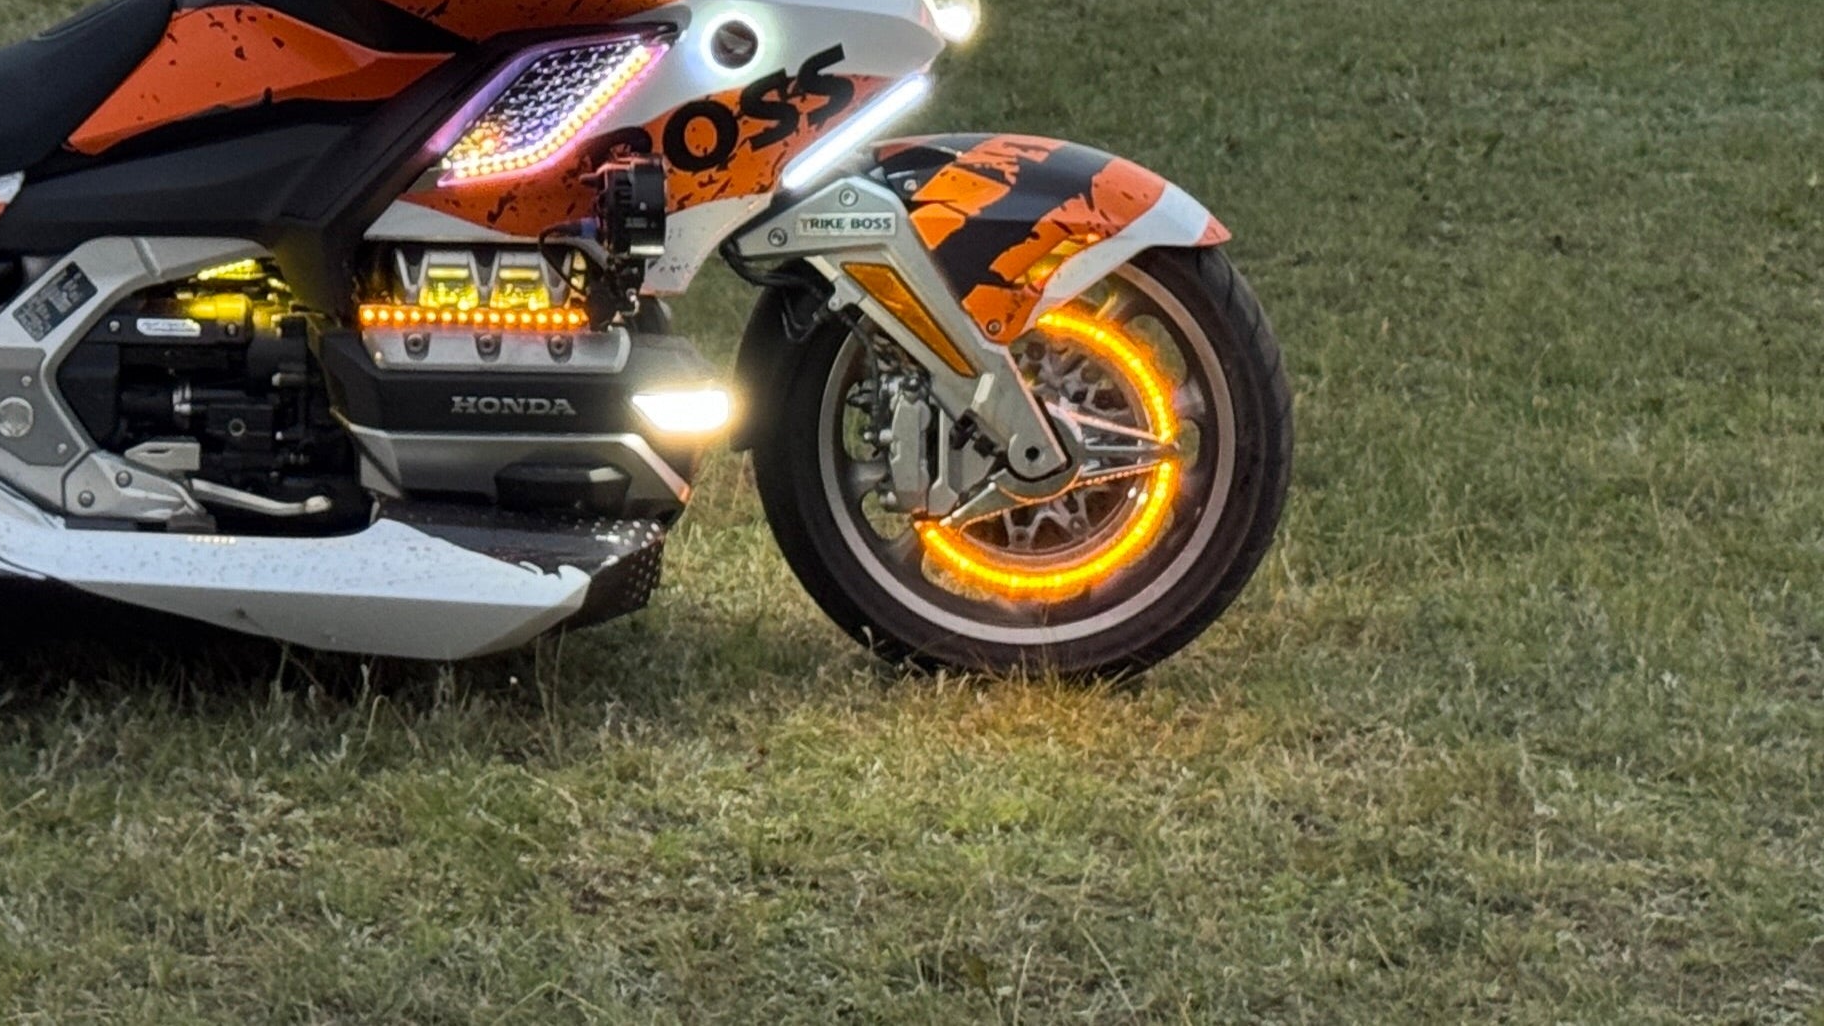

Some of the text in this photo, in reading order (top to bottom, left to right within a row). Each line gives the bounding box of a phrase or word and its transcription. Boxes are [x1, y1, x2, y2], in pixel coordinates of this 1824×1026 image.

[800, 217, 892, 233] TRIKE BOSS
[451, 396, 576, 415] HONDA
